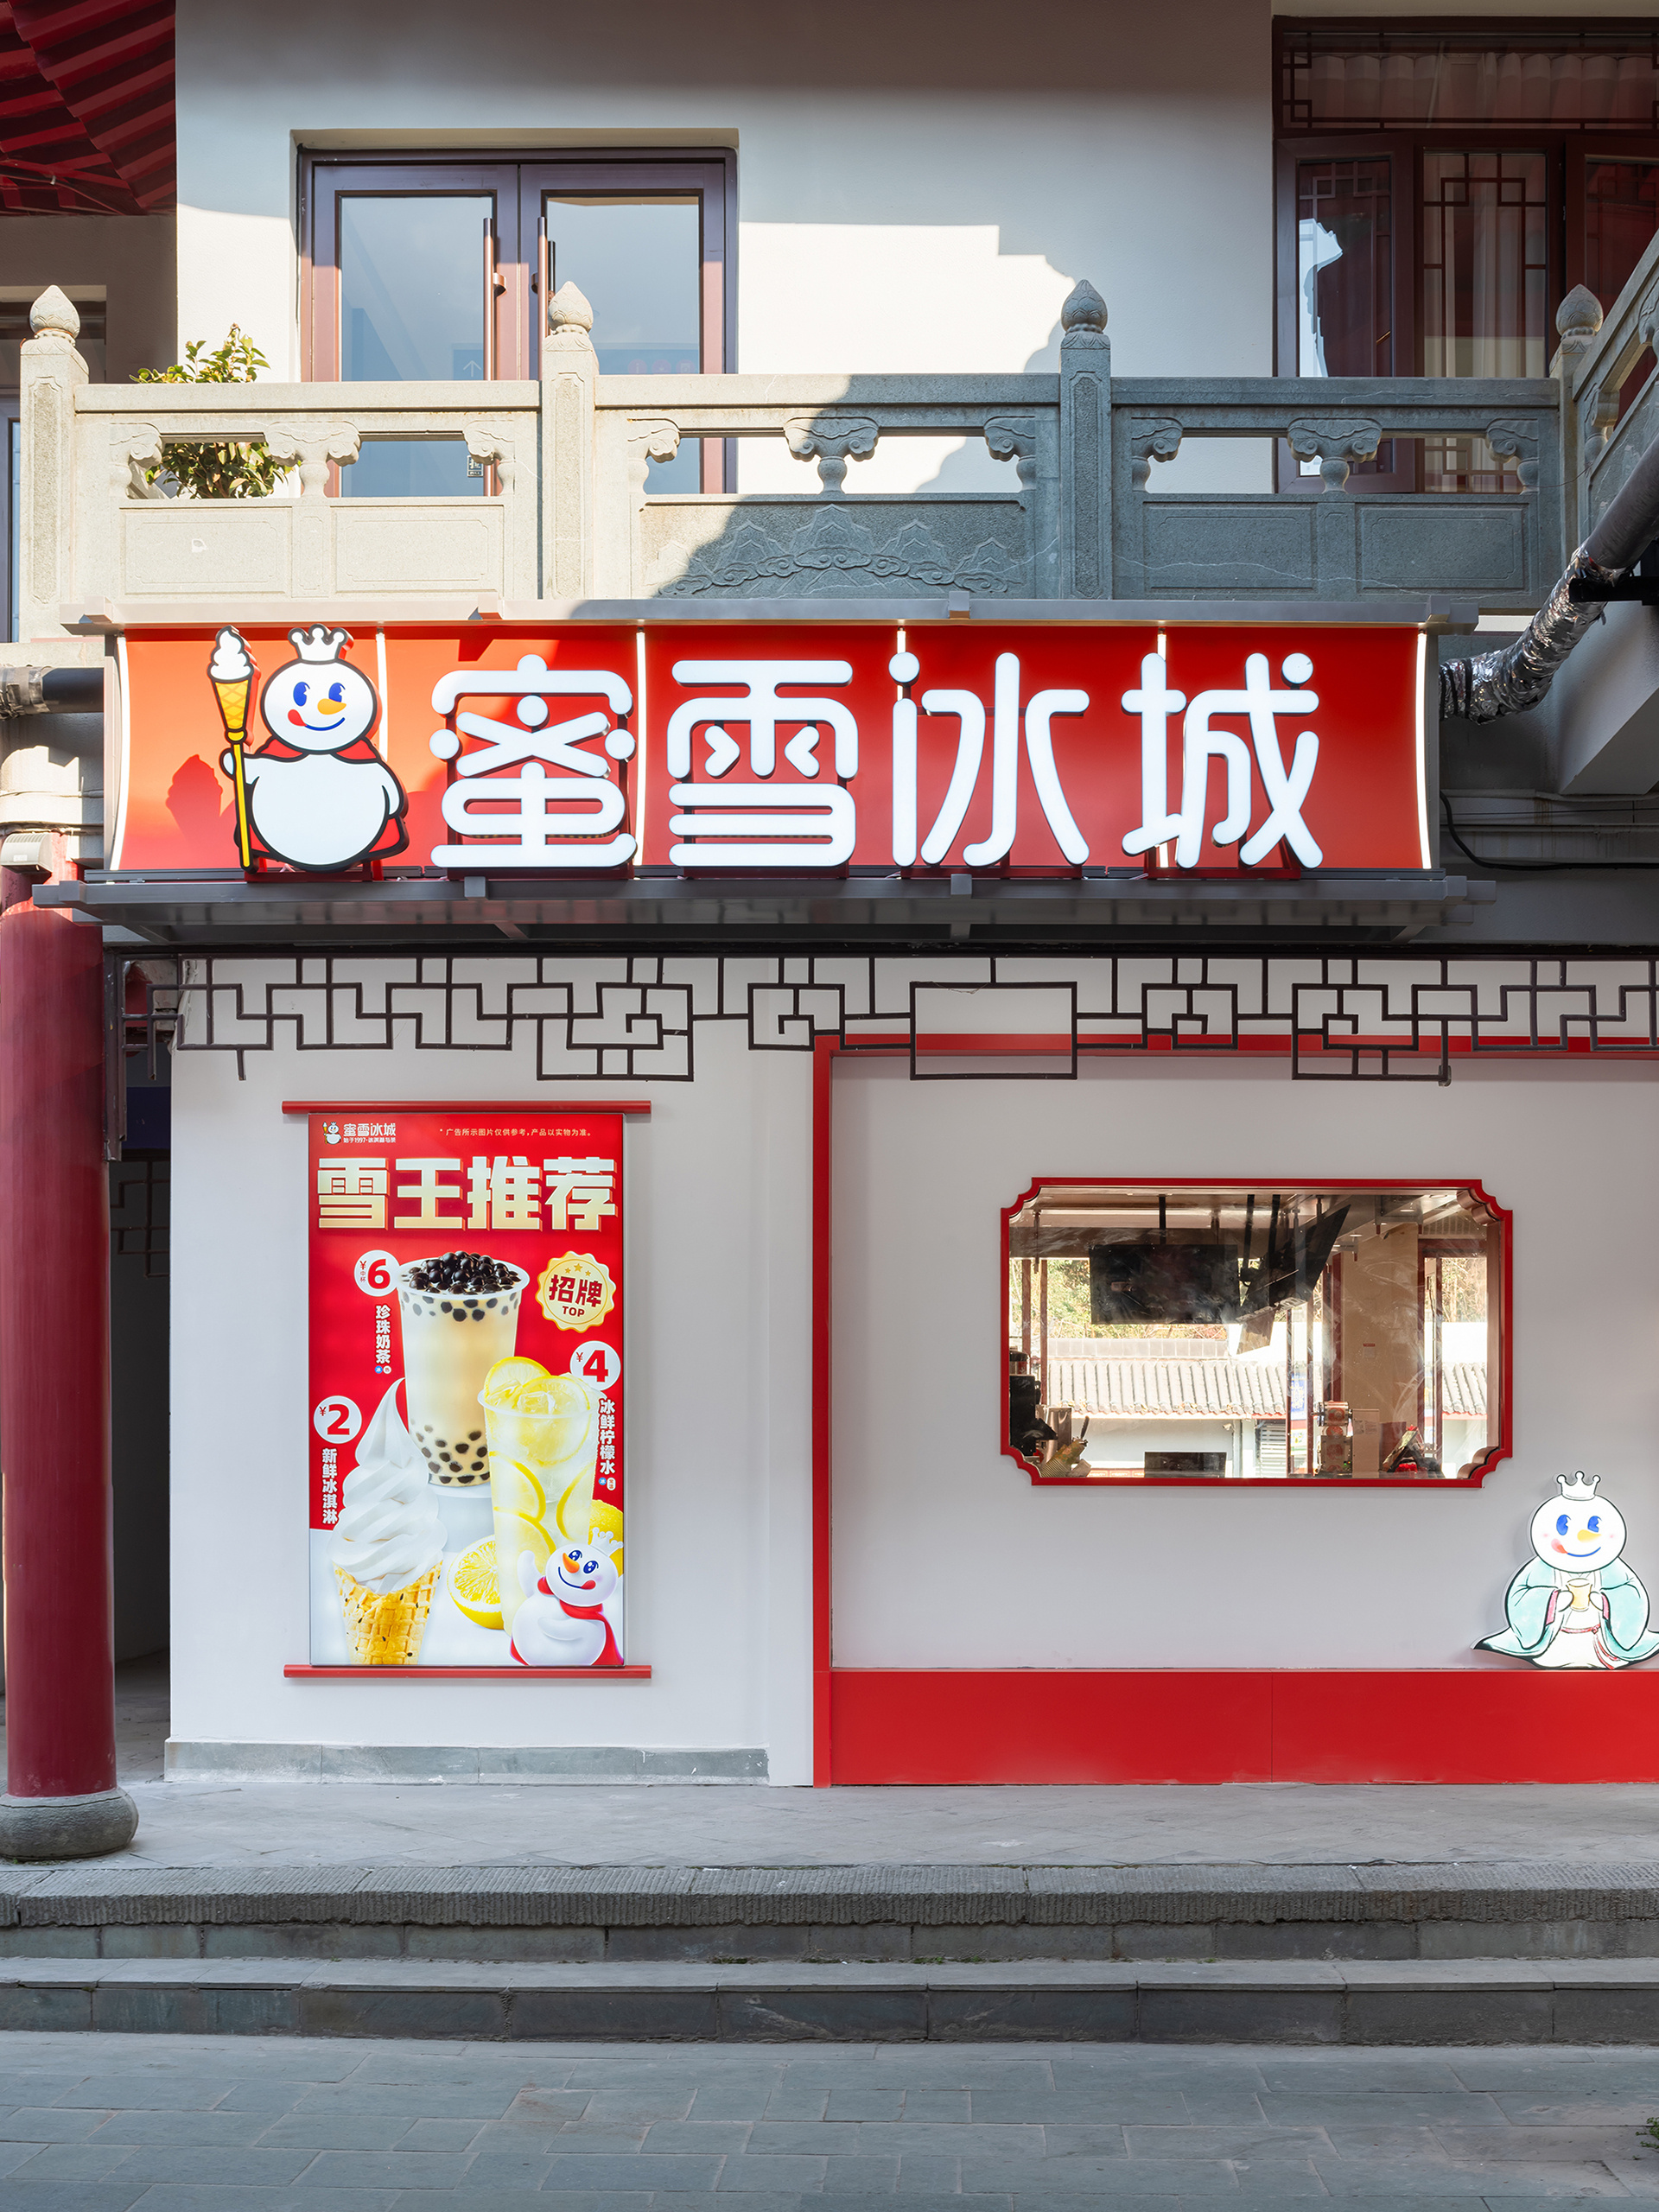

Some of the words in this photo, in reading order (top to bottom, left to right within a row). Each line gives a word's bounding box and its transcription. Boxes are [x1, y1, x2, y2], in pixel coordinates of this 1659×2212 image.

[429, 652, 1324, 869] 蜜雪冰城
[343, 1123, 396, 1136] 蜜雪冰城
[317, 1156, 618, 1231] 雪王推荐
[549, 1274, 602, 1307] 招牌
[563, 1306, 585, 1317] TOP
[375, 1304, 391, 1364] 珍珠奶茶
[600, 1399, 615, 1475] 冰鲜柠檬水
[321, 1447, 338, 1524] 新鲜冰淇淋
